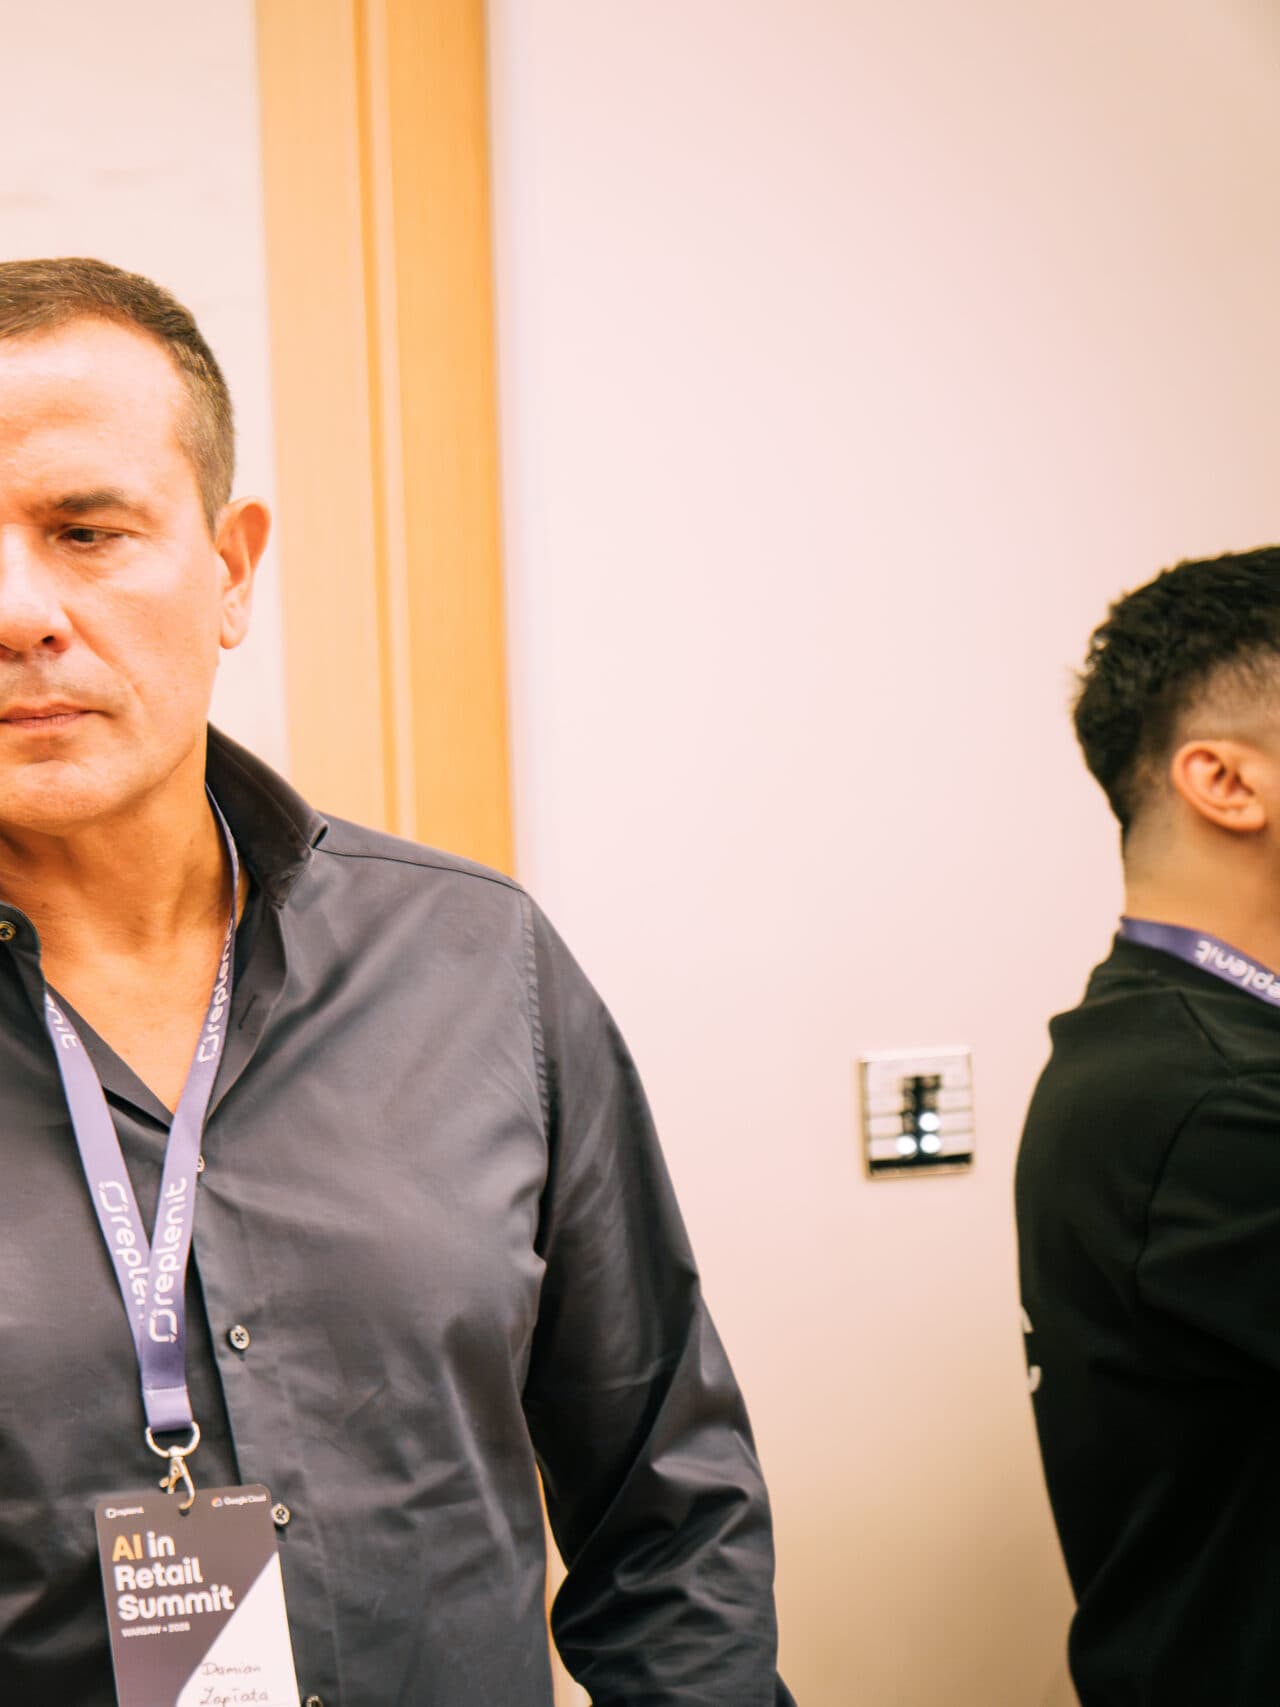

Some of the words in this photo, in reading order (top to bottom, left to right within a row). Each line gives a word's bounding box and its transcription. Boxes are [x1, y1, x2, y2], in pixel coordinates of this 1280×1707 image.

[1195, 940, 1280, 999] eplenit
[153, 1177, 187, 1305] replenit
[111, 1215, 151, 1320] reple
[112, 1533, 143, 1562] AI
[146, 1531, 176, 1558] in
[114, 1557, 204, 1591] Retail
[118, 1584, 235, 1621] Summit
